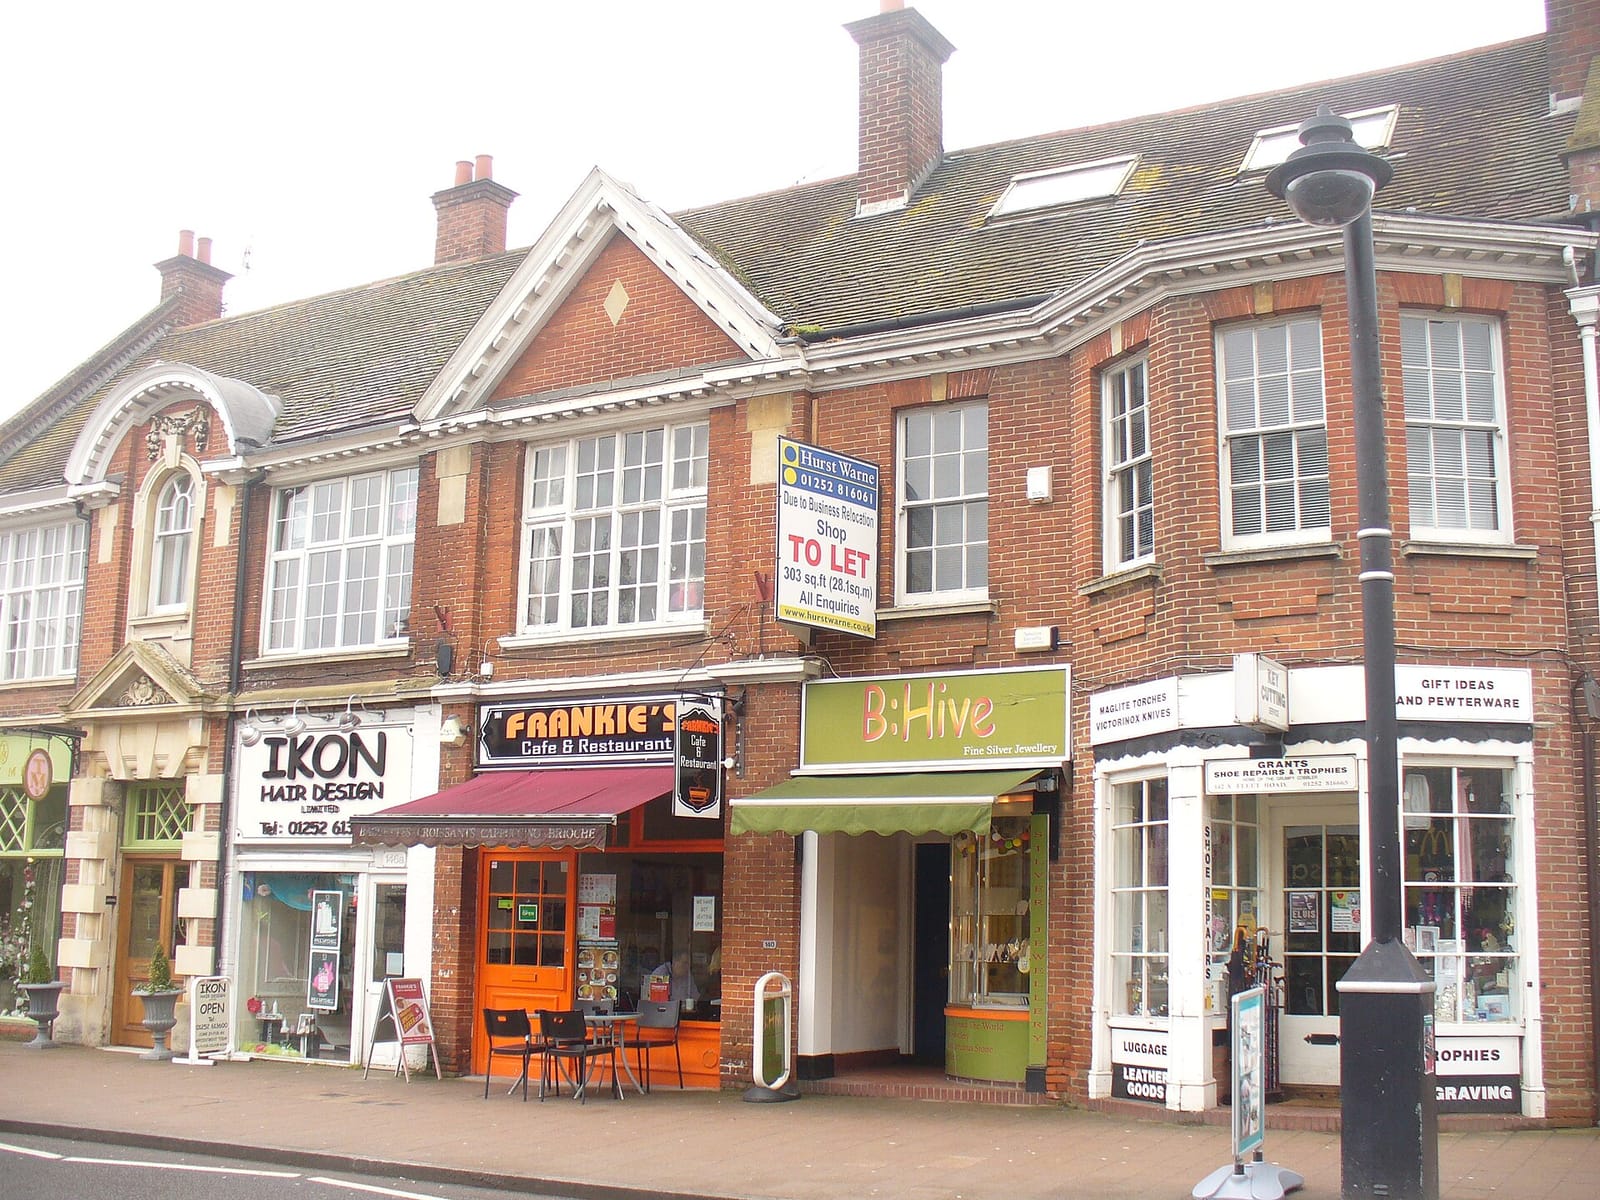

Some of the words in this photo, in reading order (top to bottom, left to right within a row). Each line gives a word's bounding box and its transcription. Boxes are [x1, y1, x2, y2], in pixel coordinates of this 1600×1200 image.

[800, 449, 837, 474] Hurst
[839, 459, 875, 485] Warne
[800, 473, 834, 493] 01252
[837, 483, 874, 505] 816061
[783, 491, 798, 507] Due
[799, 494, 807, 509] to
[808, 497, 840, 518] Business
[841, 505, 874, 529] Relocation
[816, 519, 847, 544] Shop
[788, 534, 822, 567] TO
[830, 544, 870, 579] LET
[783, 566, 802, 582] 303
[804, 573, 827, 590] sq.ft
[799, 591, 813, 606] All
[816, 593, 860, 616] Enquiries
[784, 607, 872, 633] www.hurstwarne.co.uk
[1422, 679, 1450, 689] GIFT
[1456, 680, 1494, 690] IDEAS
[1099, 701, 1131, 715] MAGLITE
[1132, 692, 1167, 708] TORCHES
[1396, 696, 1423, 706] AND
[1428, 696, 1520, 708] PEWTERWARE
[506, 703, 675, 739] FRANKIE'S
[863, 682, 995, 743] B:Hive
[1095, 715, 1141, 731] VICTORINOX
[1142, 708, 1171, 722] KNIVES
[522, 739, 557, 755] Cafe
[562, 740, 574, 754] &
[578, 738, 672, 754] Restaurant
[690, 734, 707, 747] Cafe
[262, 731, 387, 780] IKON
[696, 746, 701, 758] &
[963, 746, 985, 756] Fine
[986, 745, 1012, 755] Silver
[1014, 744, 1057, 755] Jewellery
[680, 755, 717, 770] Restaurant
[1257, 760, 1308, 769] GRANTS
[1242, 769, 1285, 777] REPAIRS
[1297, 767, 1348, 775] TROPHIES
[260, 785, 307, 802] HAIR
[312, 782, 385, 802] DESIGN
[301, 804, 341, 814] LIMITED
[288, 821, 328, 835] 01252
[548, 828, 596, 839] BRIOCHE
[1292, 910, 1316, 919] ELVIS
[200, 982, 226, 994] IKON
[200, 1003, 225, 1014] OPEN
[1123, 1041, 1167, 1056] LUGGAGE
[1127, 1081, 1165, 1099] GOODS
